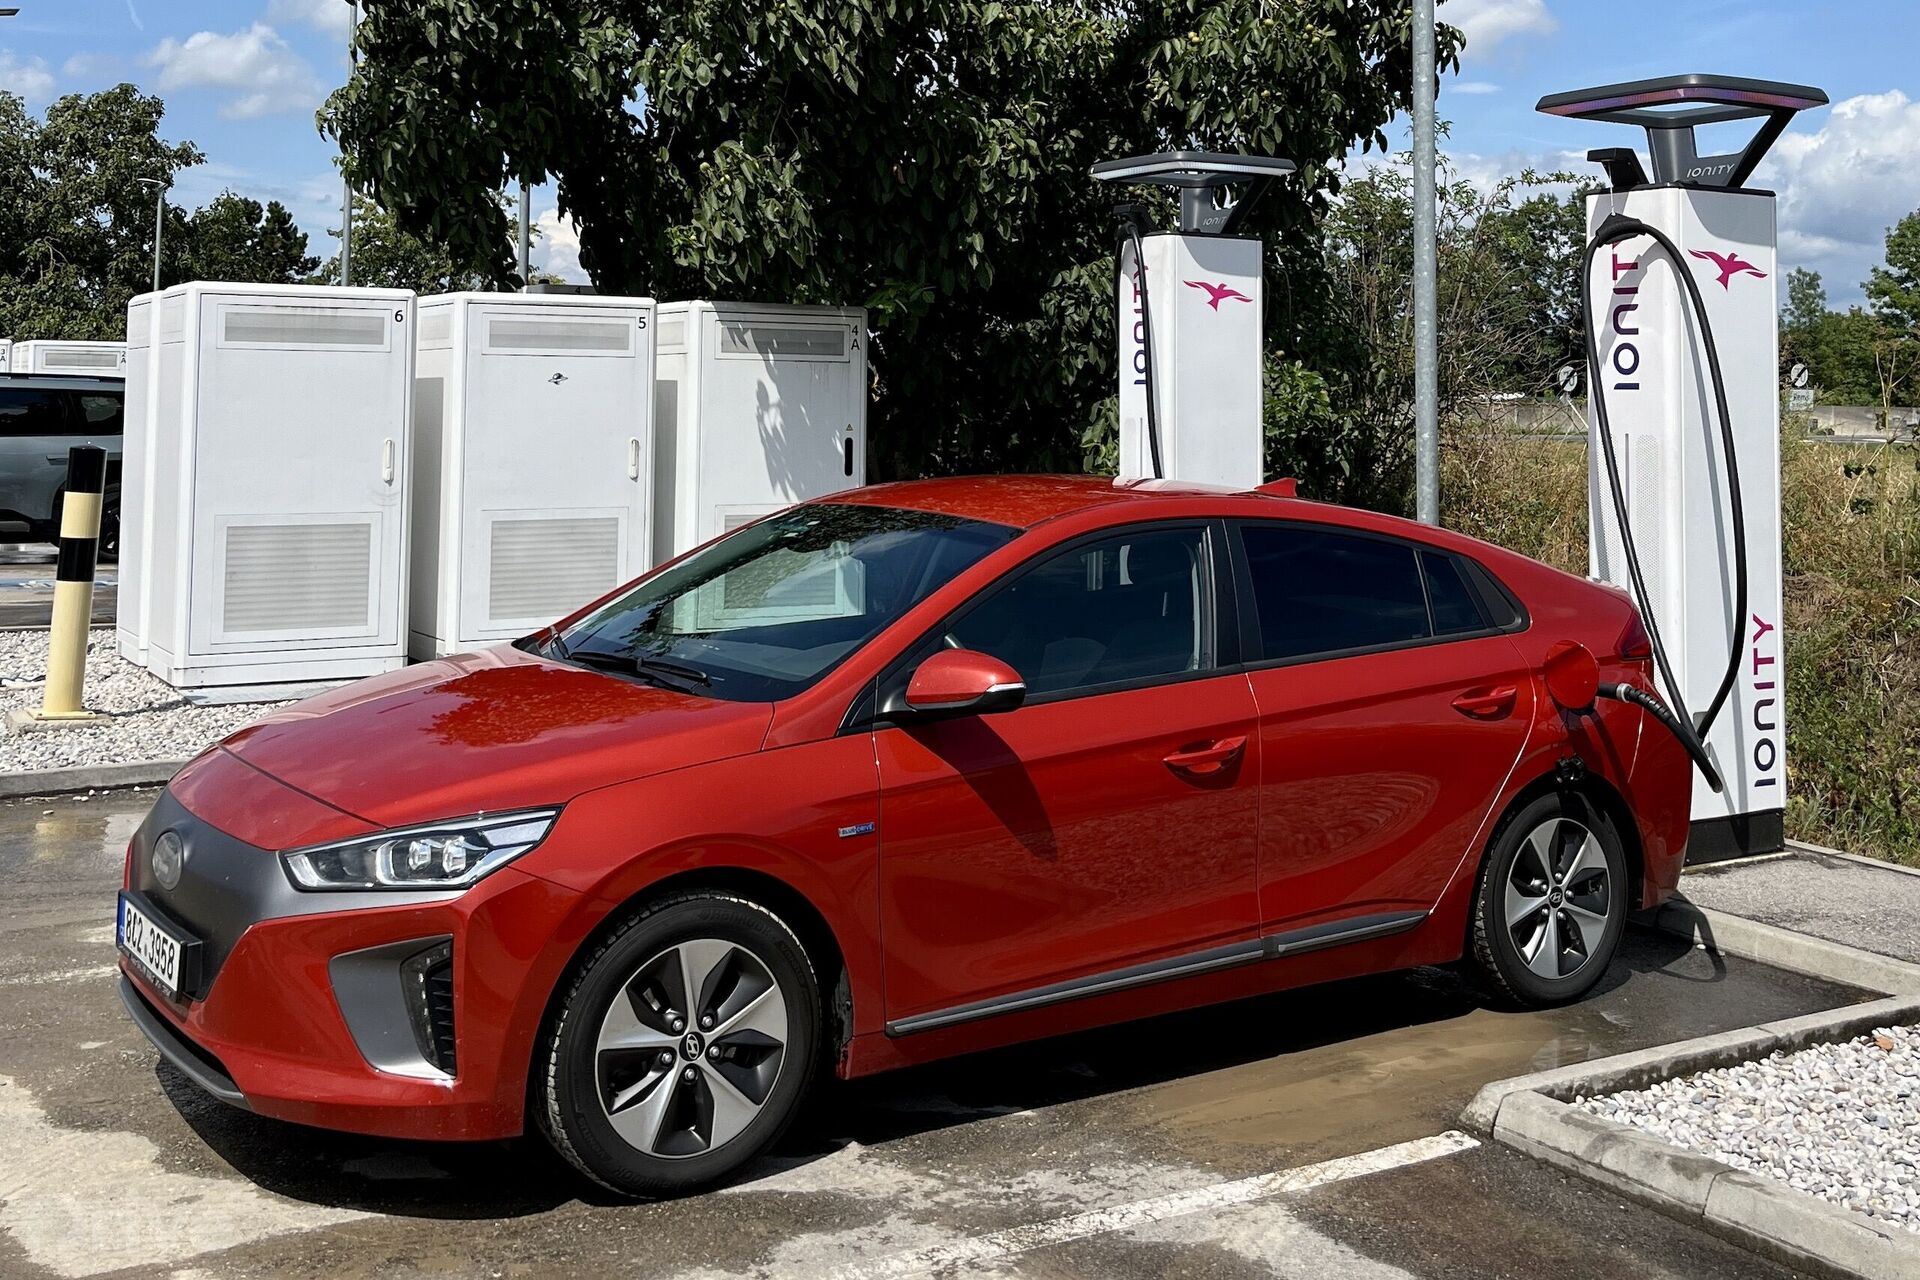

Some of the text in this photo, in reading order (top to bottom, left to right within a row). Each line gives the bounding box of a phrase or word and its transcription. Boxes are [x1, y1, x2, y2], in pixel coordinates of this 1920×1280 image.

[1686, 163, 1735, 178] IONITY
[1202, 215, 1228, 226] IONIT
[394, 309, 404, 323] 6
[638, 316, 647, 329] 5
[1612, 241, 1640, 390] IONIT
[851, 324, 859, 336] 4
[850, 338, 860, 351] A
[1752, 613, 1776, 787] IONITY
[126, 907, 144, 954] 8C2
[148, 927, 175, 980] 3958
